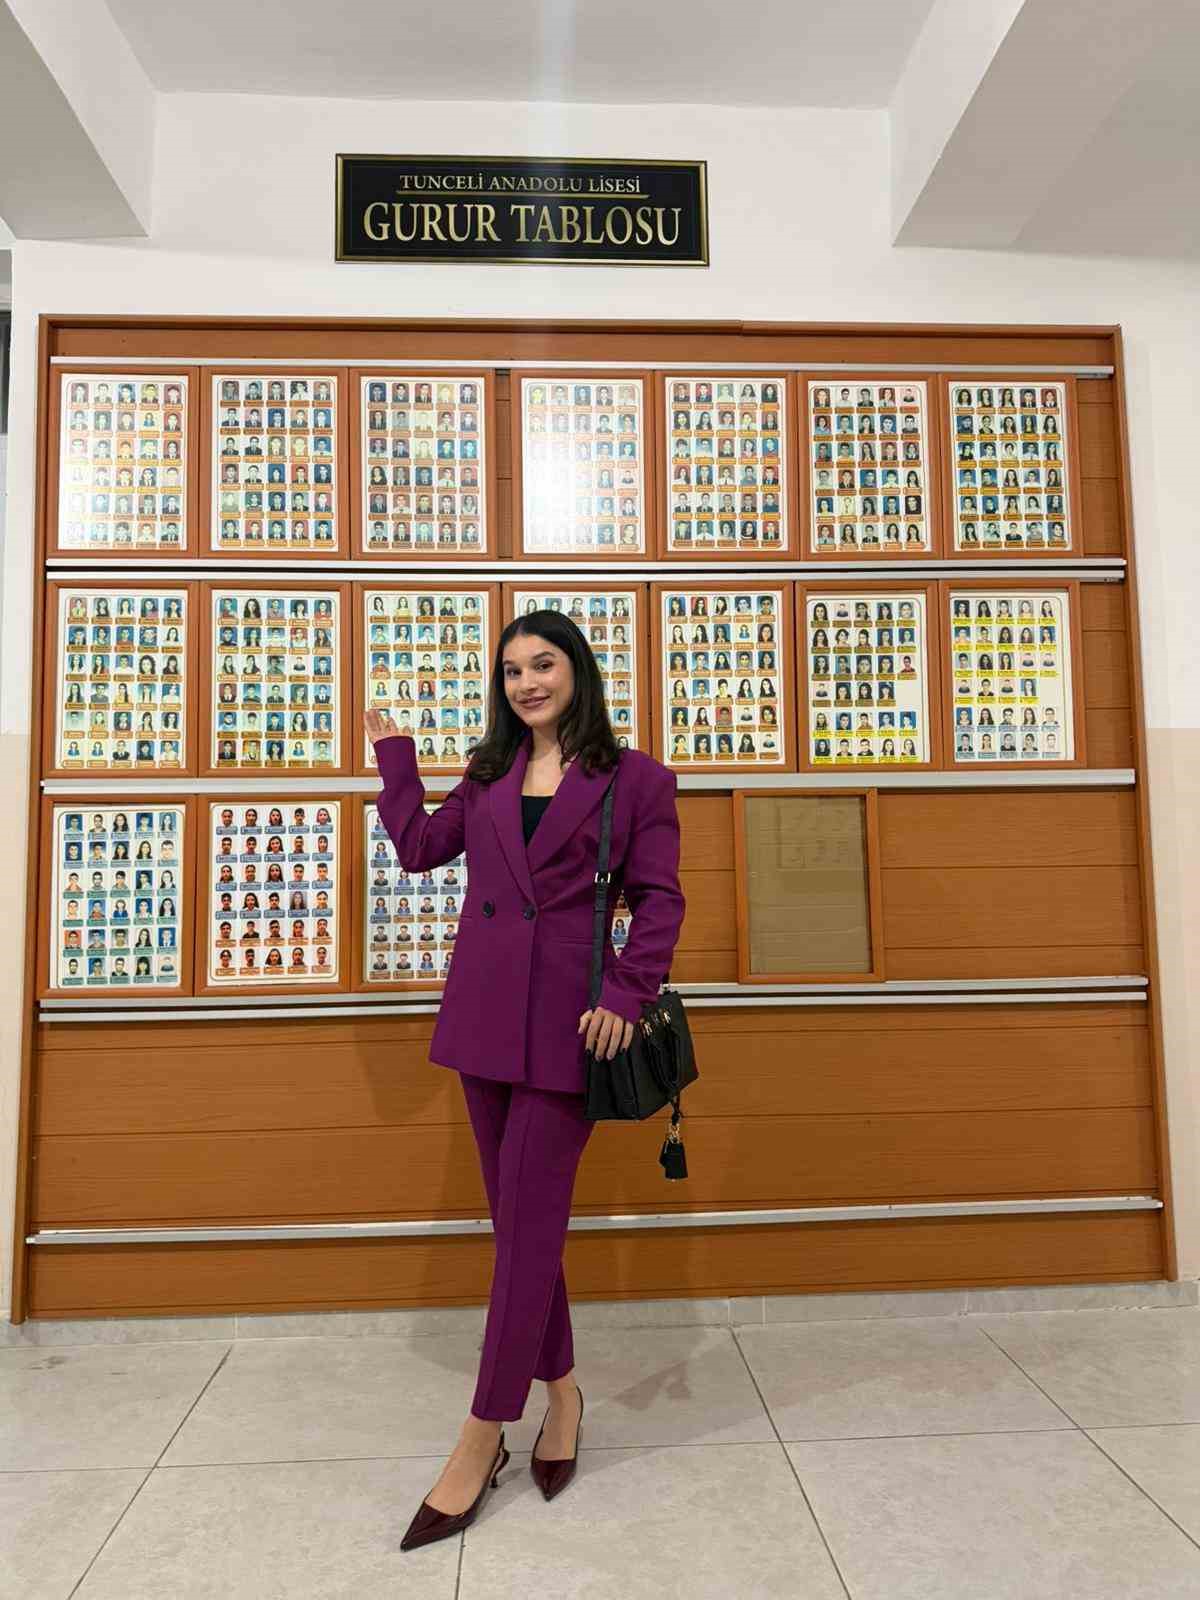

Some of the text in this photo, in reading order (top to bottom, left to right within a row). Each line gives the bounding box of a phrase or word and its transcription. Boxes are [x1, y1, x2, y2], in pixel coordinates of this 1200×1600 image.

[400, 173, 641, 193] TUNCELİ ANADOLU LİSESİ
[363, 202, 682, 246] GURUR TABLOSU
